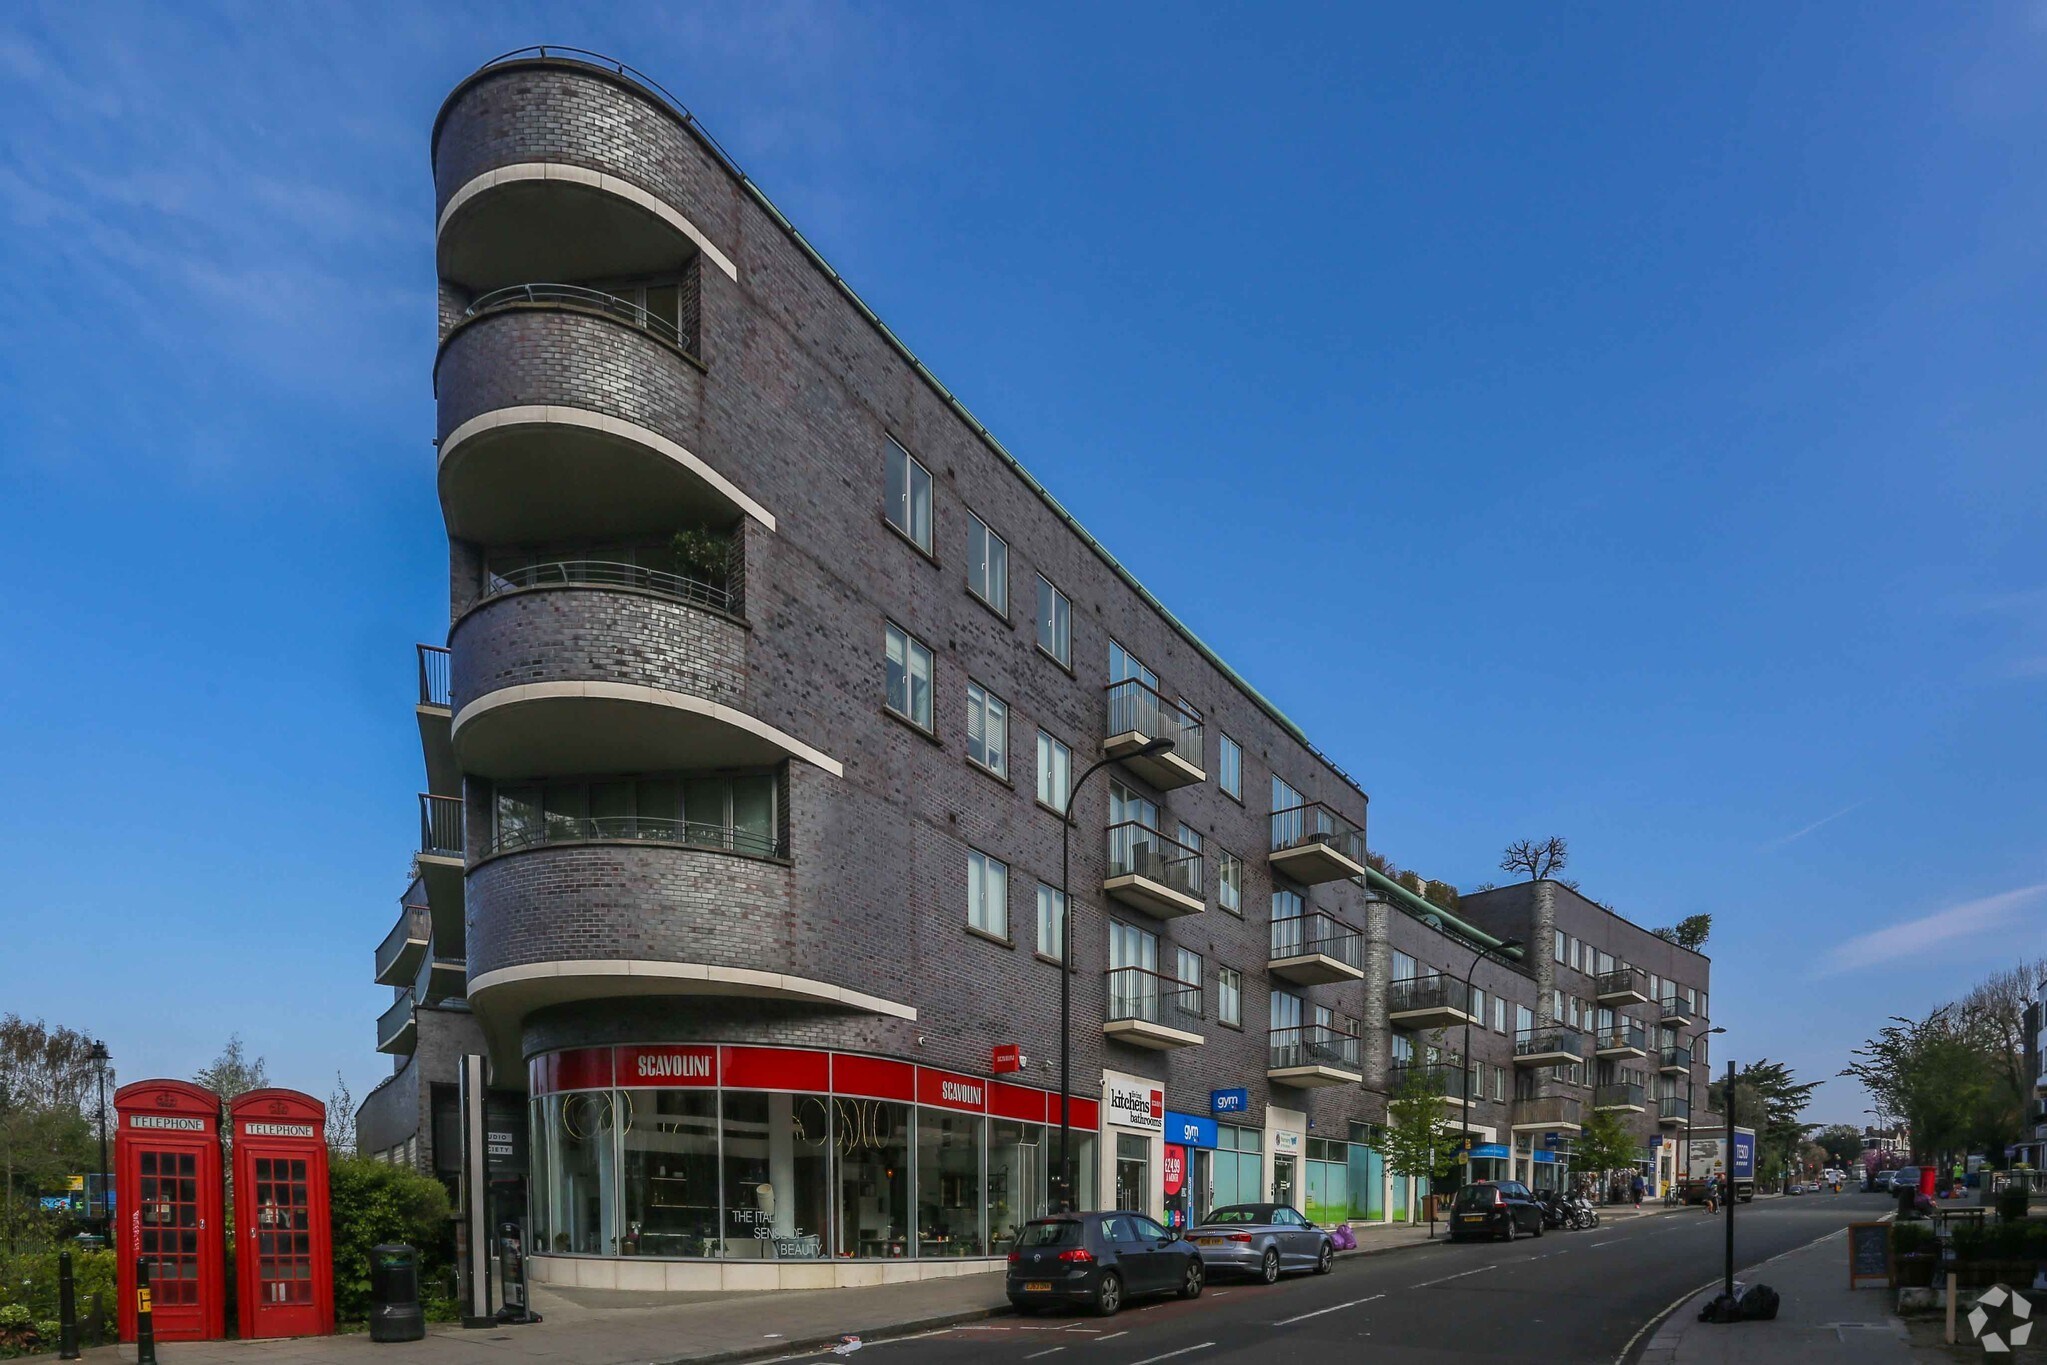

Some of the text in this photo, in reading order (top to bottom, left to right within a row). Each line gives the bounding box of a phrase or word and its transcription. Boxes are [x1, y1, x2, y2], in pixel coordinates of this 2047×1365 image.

[638, 1055, 710, 1077] SCAVOLINI
[942, 1080, 982, 1105] SCAVOLINI
[1111, 1088, 1150, 1113] kitchens
[1217, 1096, 1238, 1108] gym
[133, 1116, 202, 1130] TELEPHONE
[1130, 1111, 1162, 1127] bathrooms
[249, 1124, 311, 1136] TELEPHONE
[1184, 1124, 1199, 1140] gym
[732, 1210, 753, 1223] THE
[780, 1243, 823, 1256] BEAUTY
